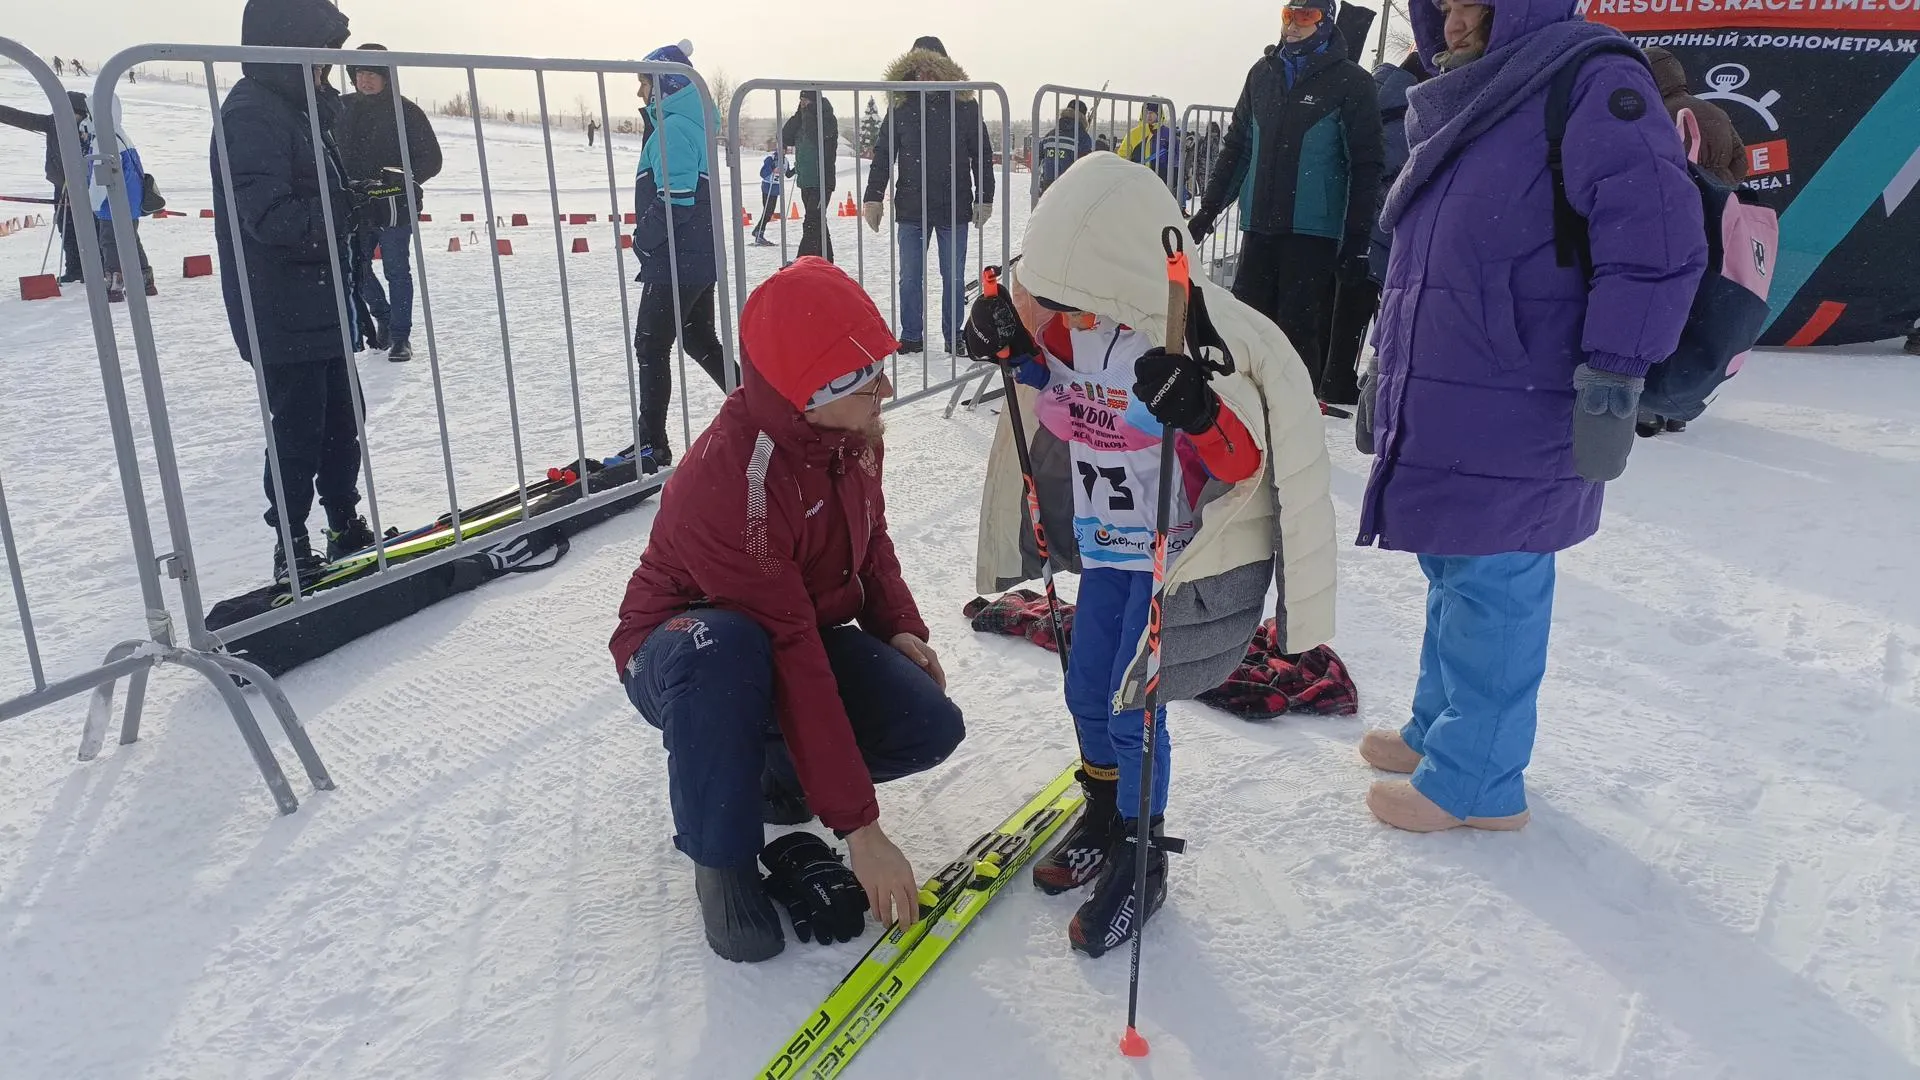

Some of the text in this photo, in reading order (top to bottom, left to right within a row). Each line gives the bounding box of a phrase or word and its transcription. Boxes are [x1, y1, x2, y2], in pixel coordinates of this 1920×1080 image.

[1743, 34, 1918, 53] ХРОНОМЕТРАЖ
[1151, 367, 1182, 408] NORDSKI
[988, 846, 1033, 900] FISCHER
[1104, 885, 1136, 948] alpin
